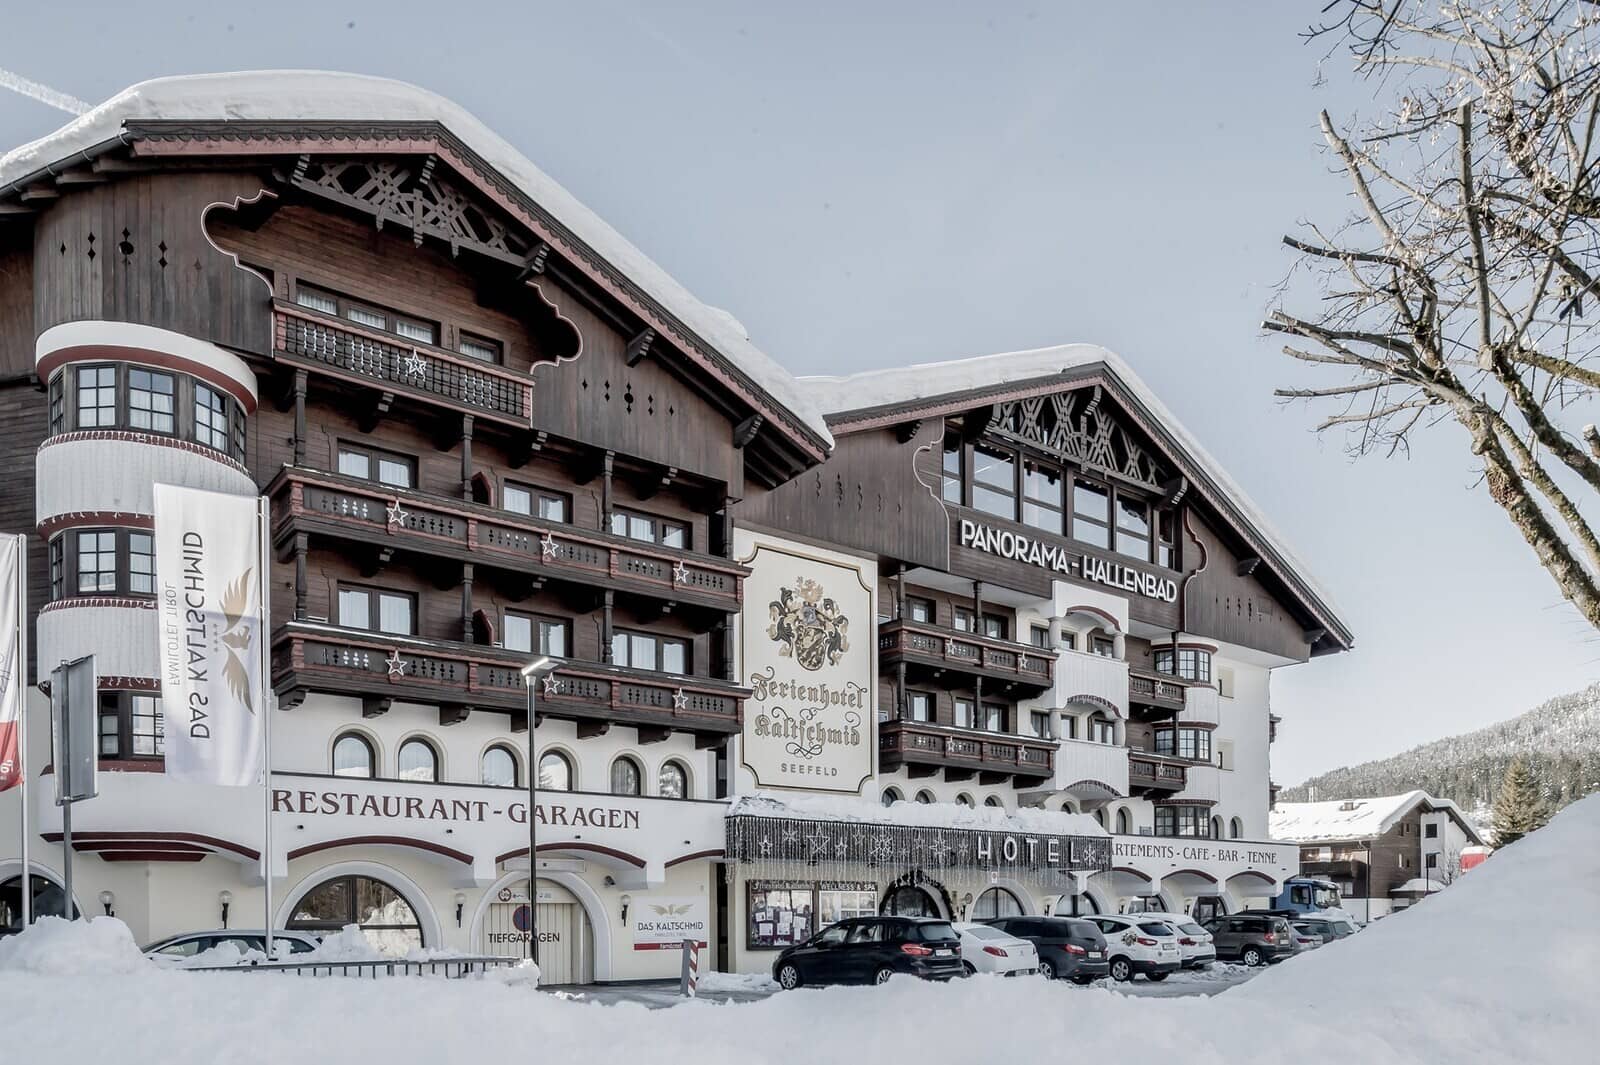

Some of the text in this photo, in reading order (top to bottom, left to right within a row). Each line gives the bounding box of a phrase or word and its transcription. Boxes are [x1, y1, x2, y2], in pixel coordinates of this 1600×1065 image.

[961, 520, 1069, 574] PANORAMA
[1082, 555, 1178, 603] HALLENBAD
[750, 666, 868, 709] Ferienhotel
[754, 705, 862, 748] Kaltschmid
[781, 763, 837, 776] SEEFELD
[272, 789, 489, 822] RESTAURANT
[977, 836, 1080, 863] HOTEL
[1111, 843, 1174, 859] RTEMENTS
[1182, 847, 1210, 861] CAFE
[1218, 849, 1239, 862] BAR
[1247, 851, 1277, 864] TENNE
[488, 932, 560, 943] TIEFGARGEN
[637, 921, 703, 931] DAS KALTSCHMID
